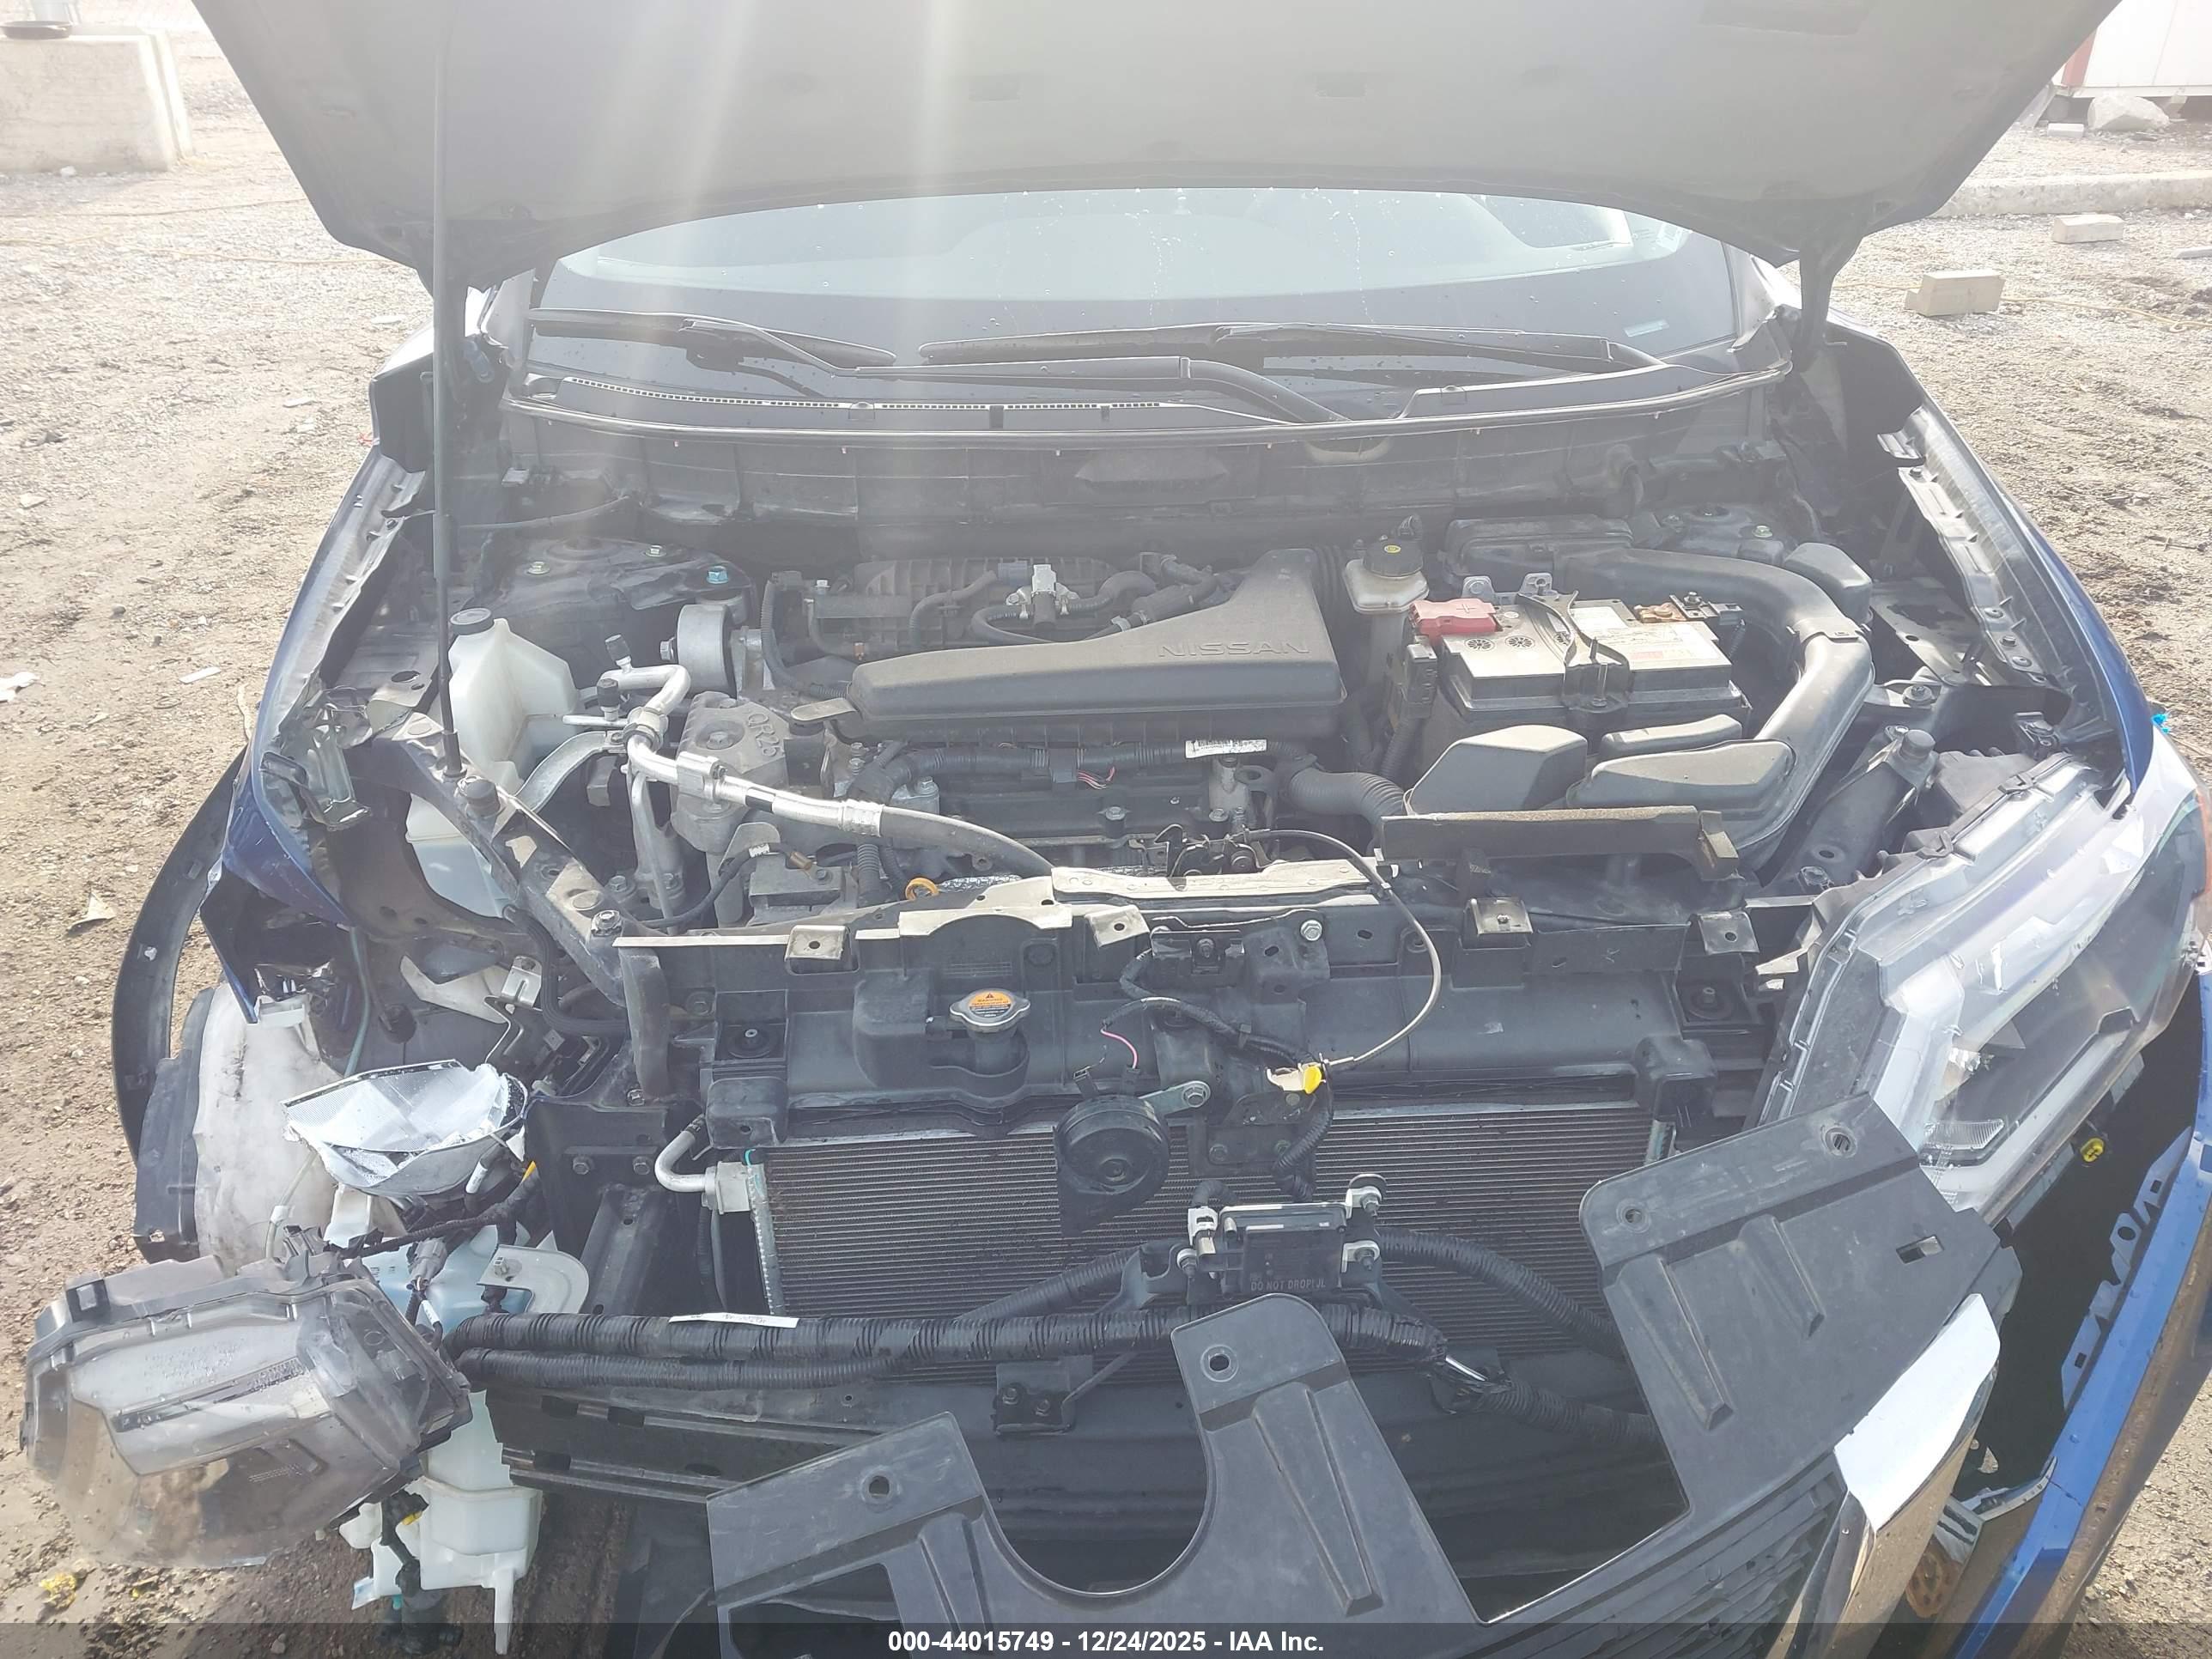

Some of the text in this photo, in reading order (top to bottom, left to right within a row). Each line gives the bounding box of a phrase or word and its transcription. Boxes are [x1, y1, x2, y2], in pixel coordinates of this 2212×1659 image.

[1158, 641, 1310, 658] NISSAN
[1250, 1281, 1264, 1291] DO
[1266, 1280, 1285, 1291] NOT
